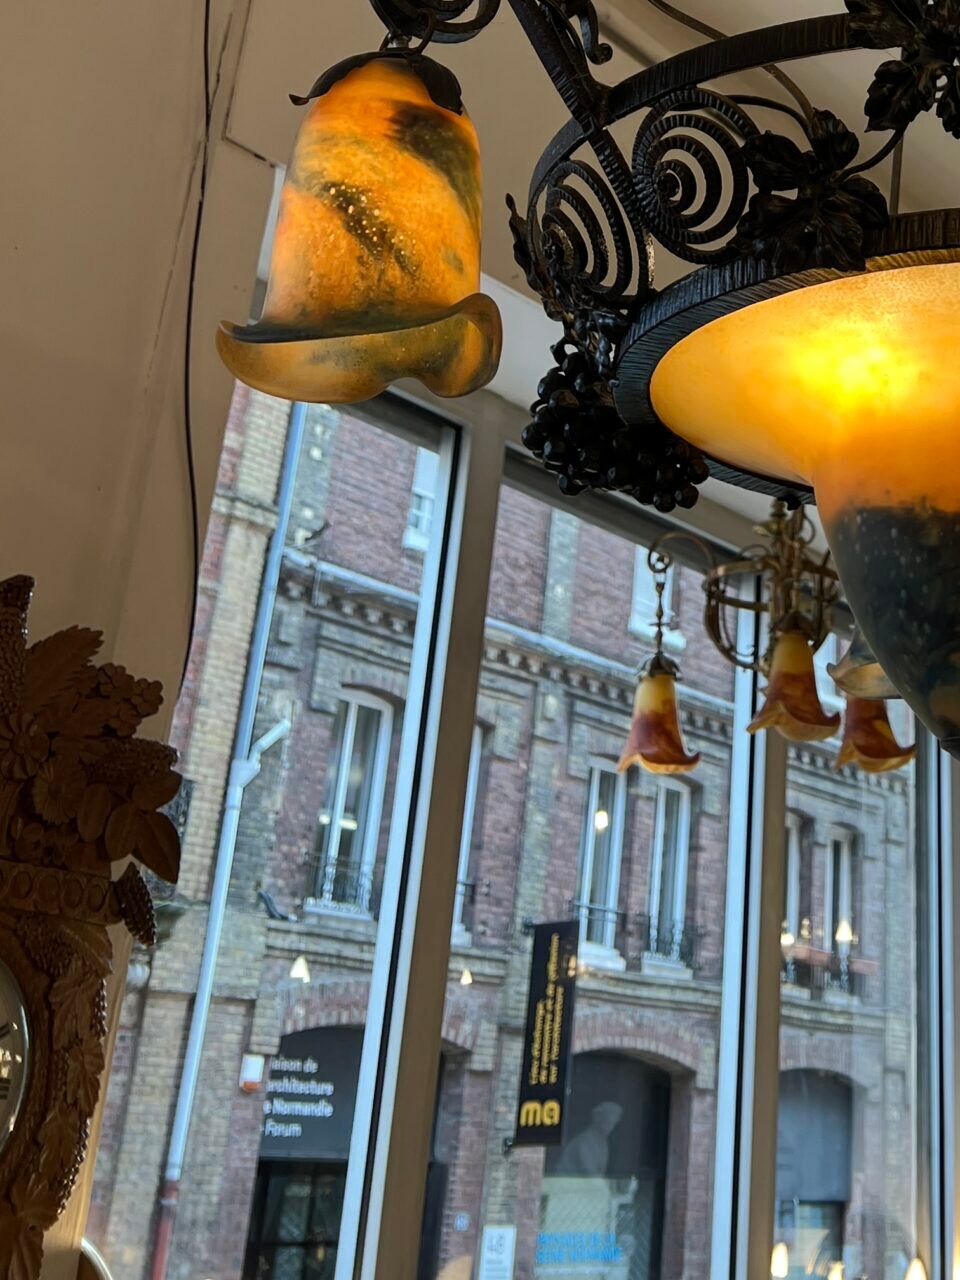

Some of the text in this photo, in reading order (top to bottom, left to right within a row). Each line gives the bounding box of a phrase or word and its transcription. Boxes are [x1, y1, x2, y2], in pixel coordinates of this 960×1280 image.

[270, 1055, 319, 1073] aison de
[266, 1075, 334, 1096] architecture
[272, 1097, 333, 1118] Normandie
[520, 1099, 560, 1127] ma
